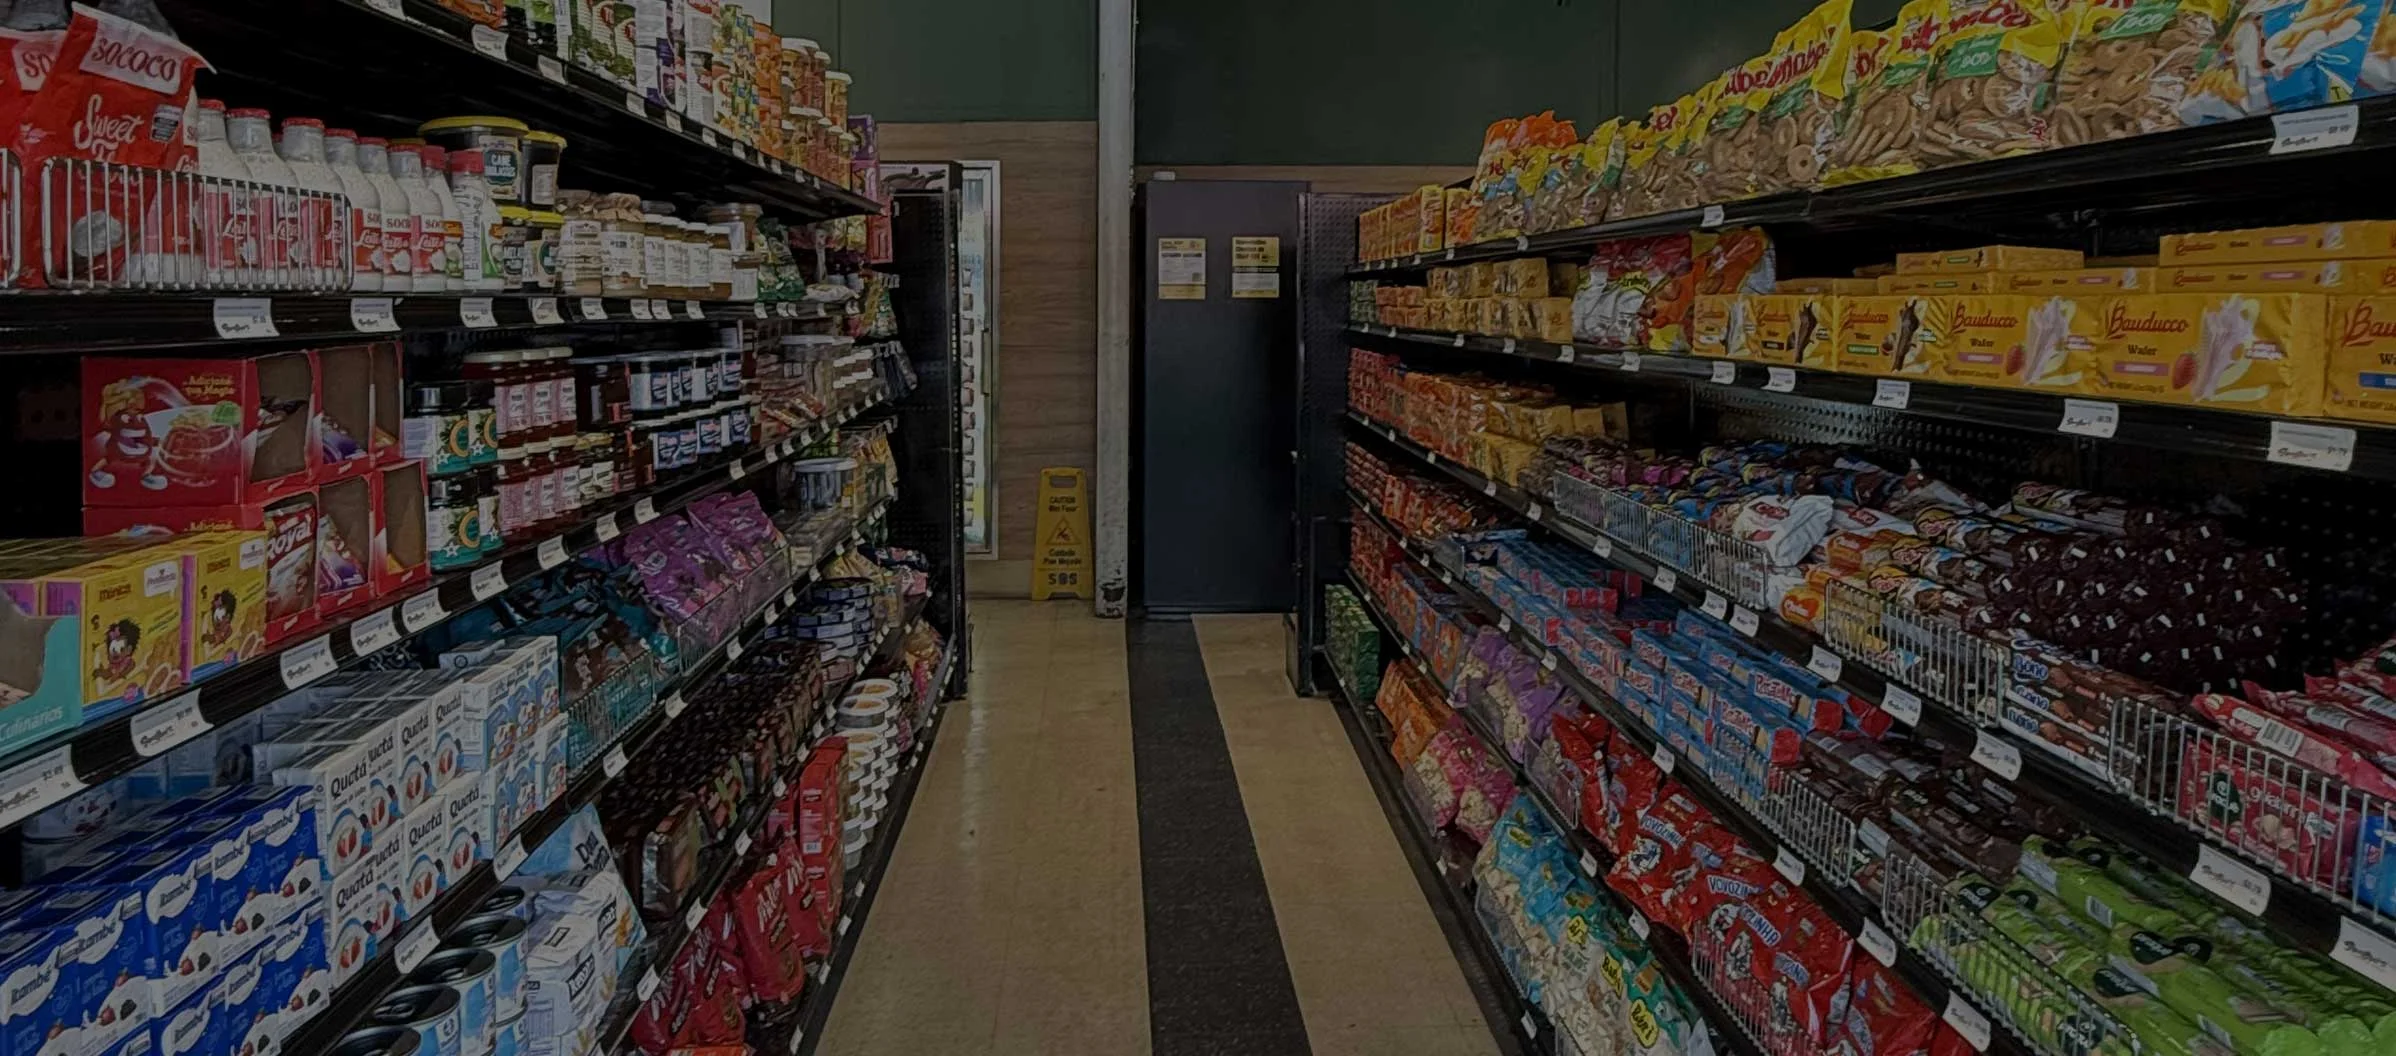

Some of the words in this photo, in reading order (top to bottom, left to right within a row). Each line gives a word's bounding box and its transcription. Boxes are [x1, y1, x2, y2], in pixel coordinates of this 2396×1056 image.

[92, 38, 177, 82] SOCOCO
[73, 94, 144, 150] Sweet
[1951, 302, 2019, 335] Bauducco
[2105, 300, 2190, 340] Bauducco
[2127, 344, 2158, 356] Wafer
[330, 757, 367, 800] Quatá
[449, 788, 480, 818] Quatá
[409, 811, 443, 847] Quatá
[336, 867, 374, 909] Quatá
